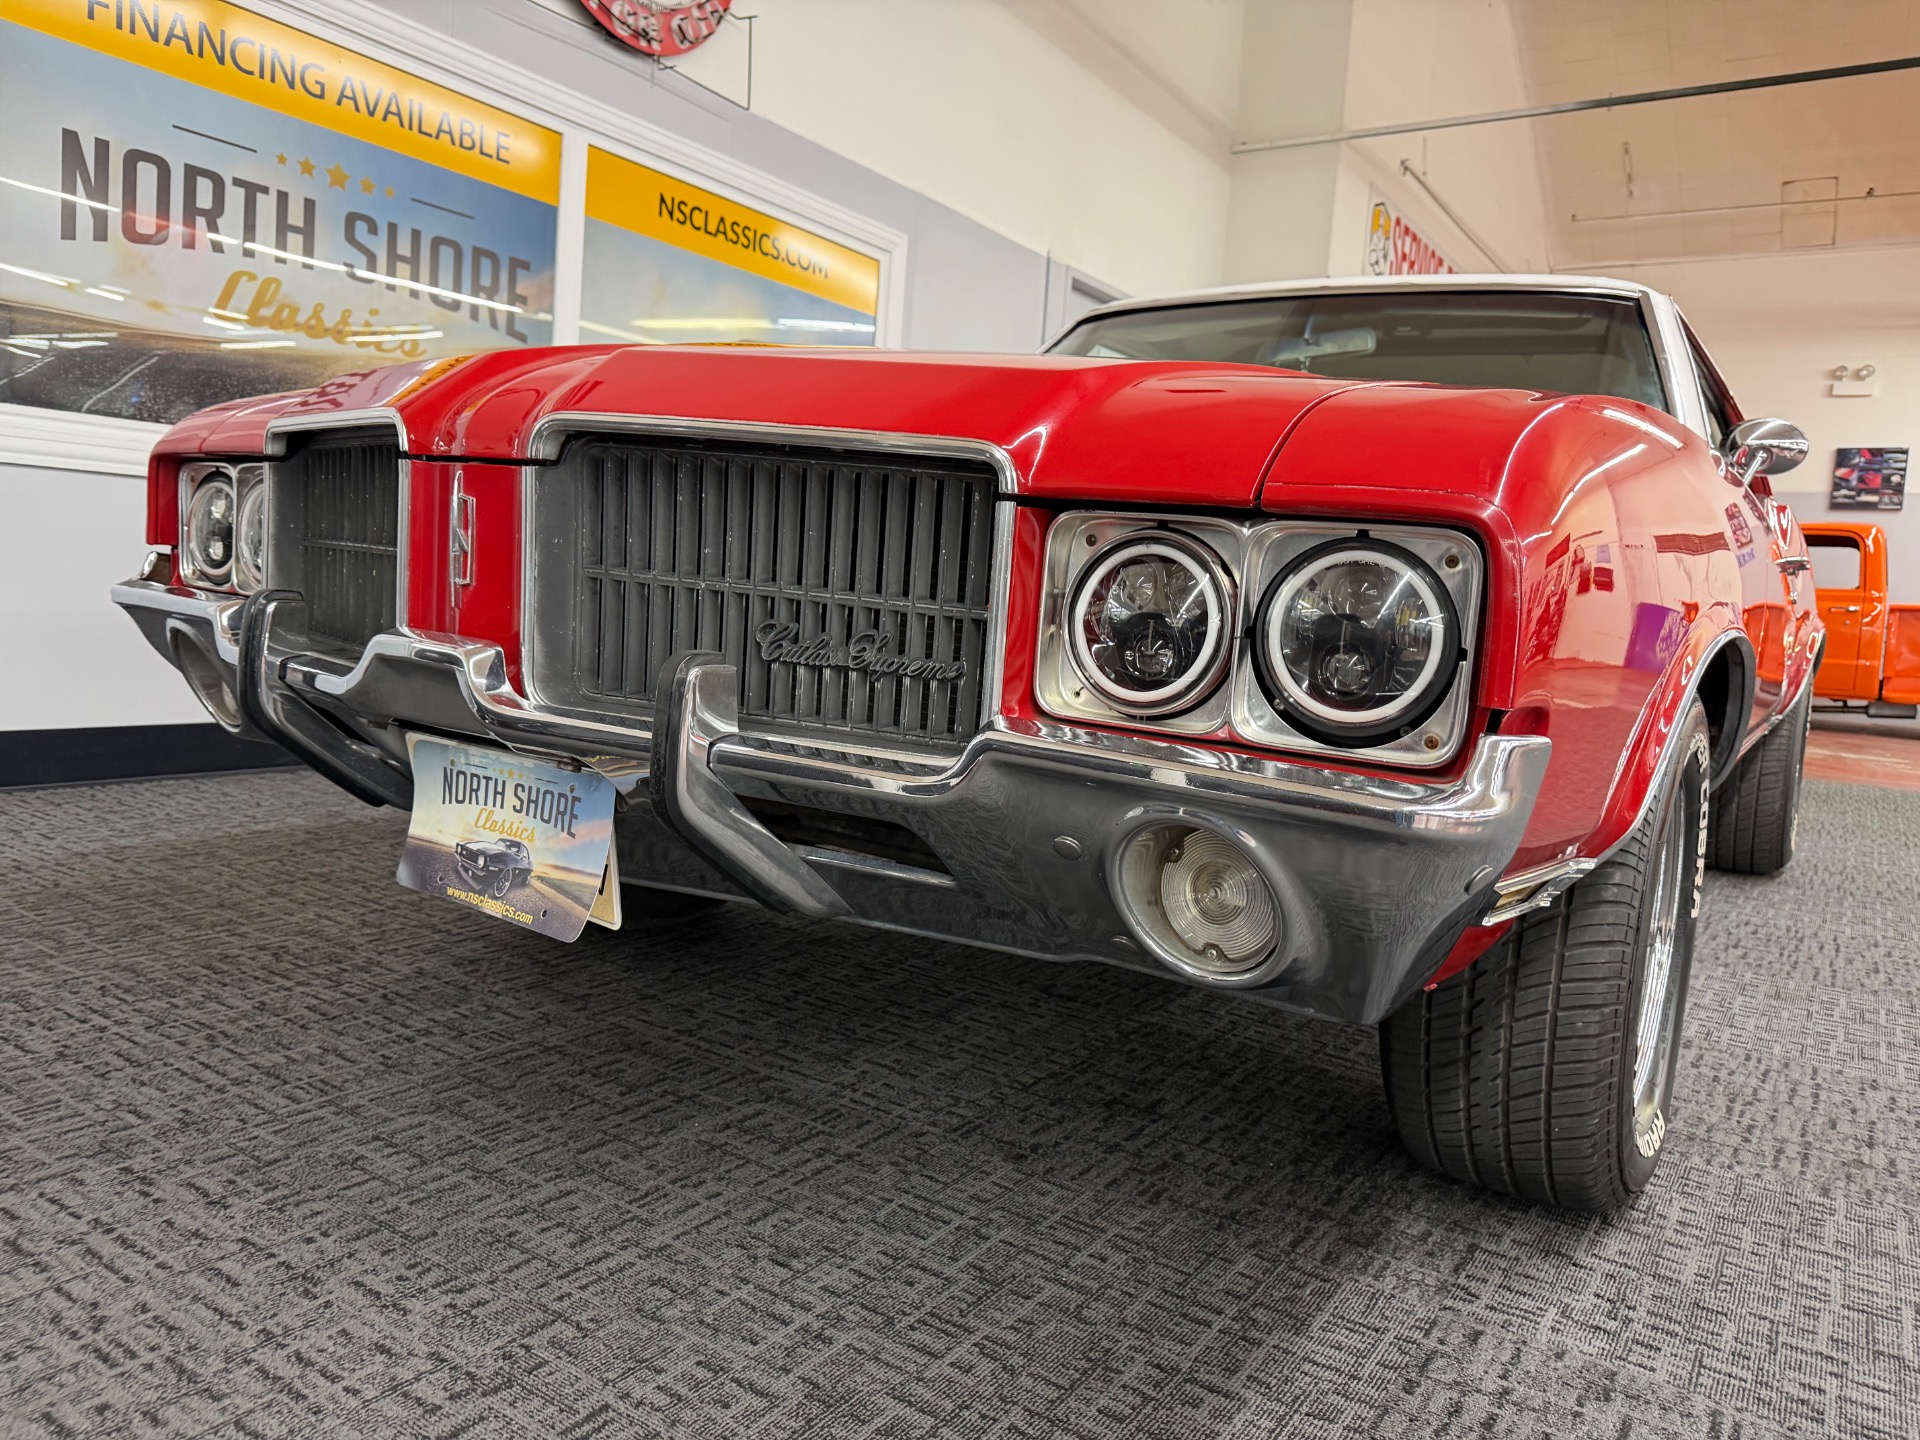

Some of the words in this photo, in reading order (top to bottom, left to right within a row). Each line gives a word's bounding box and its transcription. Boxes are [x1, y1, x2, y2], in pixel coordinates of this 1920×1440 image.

[87, 0, 327, 99] FINANCING
[336, 76, 511, 165] AVAILABLE
[60, 127, 316, 271] NORTH
[343, 211, 532, 344] SHORE
[659, 193, 829, 279] NSCLASSICS.COM
[1389, 217, 1443, 275] SERVI
[212, 269, 428, 357] Classics
[756, 619, 848, 666] Cutlass
[849, 630, 968, 682] Supreme
[442, 767, 506, 809] NORTH
[512, 782, 582, 840] SHORE
[475, 808, 536, 842] Classics
[1691, 779, 1709, 918] COBRA
[447, 887, 533, 924] www.nsclassics.com
[1636, 1108, 1665, 1157] RADI
